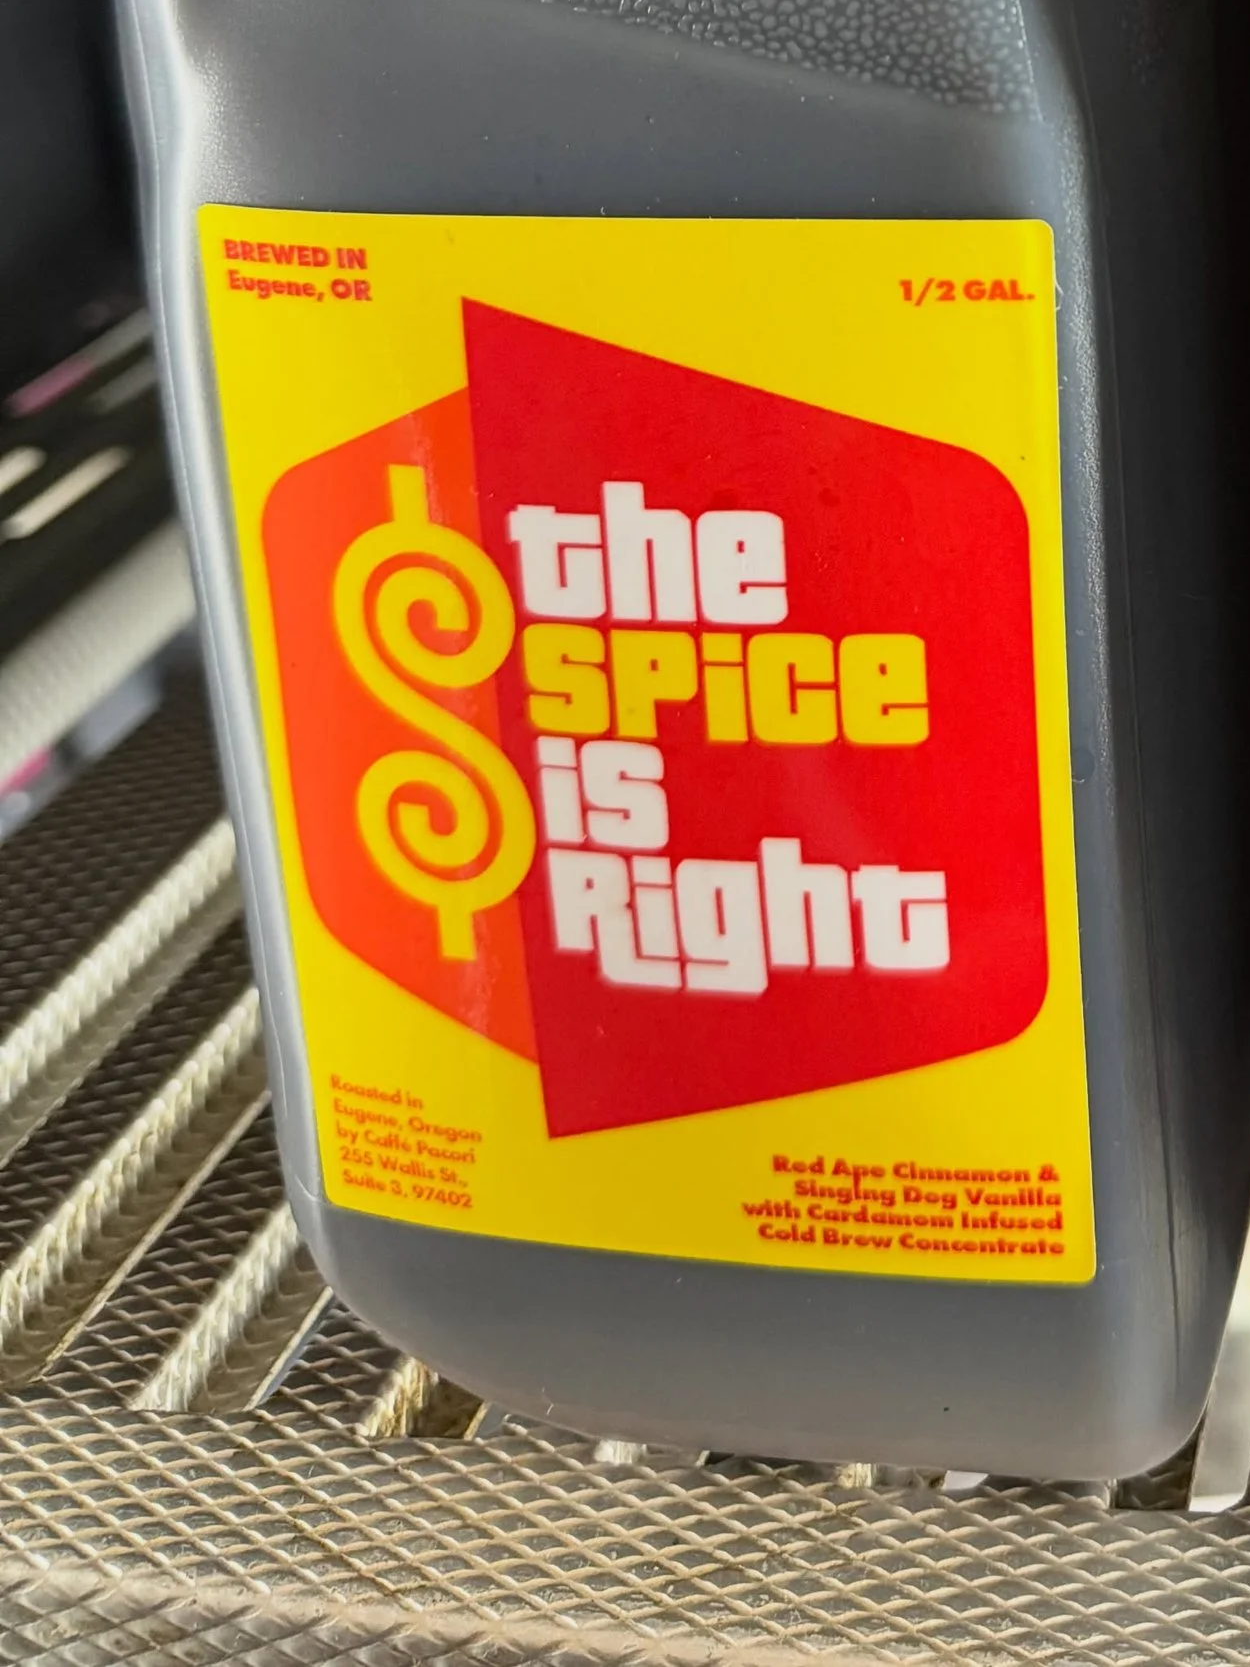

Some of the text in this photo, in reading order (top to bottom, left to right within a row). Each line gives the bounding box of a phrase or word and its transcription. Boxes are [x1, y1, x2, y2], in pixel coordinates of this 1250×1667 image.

[224, 239, 367, 270] BREWED IN
[228, 269, 372, 302] Eugene, OR
[899, 278, 1035, 307] 1/2 GAL.
[508, 480, 789, 624] the
[537, 735, 669, 850] is
[547, 836, 950, 996] Right
[330, 1074, 423, 1110] Roasted in
[334, 1098, 482, 1142] Eugene, Oregon
[337, 1120, 359, 1144] by
[417, 1141, 476, 1163] Pacori
[340, 1146, 373, 1166] 255
[378, 1154, 435, 1180] Wallis
[772, 1155, 1059, 1187] Red Ape Cinnamon &
[343, 1169, 472, 1208] Suite 3, 97402
[795, 1180, 1061, 1209] Singing Dog Vanilla
[742, 1200, 1063, 1230] with Cardamom Infused
[759, 1223, 1064, 1255] Cold Brew Concentrate
